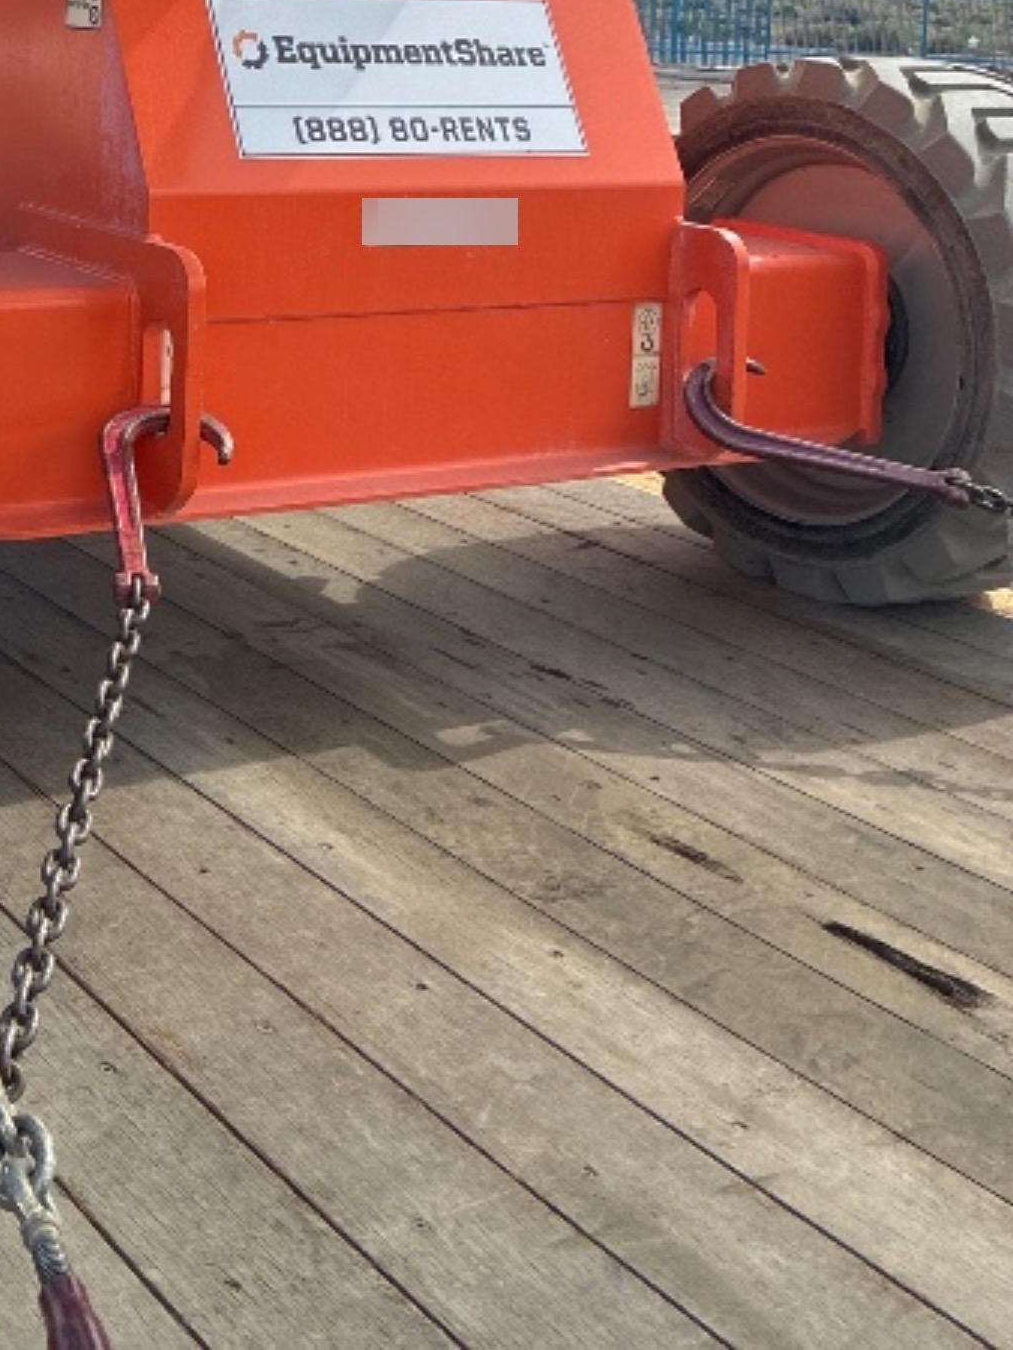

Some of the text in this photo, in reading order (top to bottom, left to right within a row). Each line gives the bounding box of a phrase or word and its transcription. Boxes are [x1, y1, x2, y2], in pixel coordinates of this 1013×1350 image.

[271, 35, 547, 71] EquipmentShare
[292, 115, 532, 145] (888) 80-RENTS
